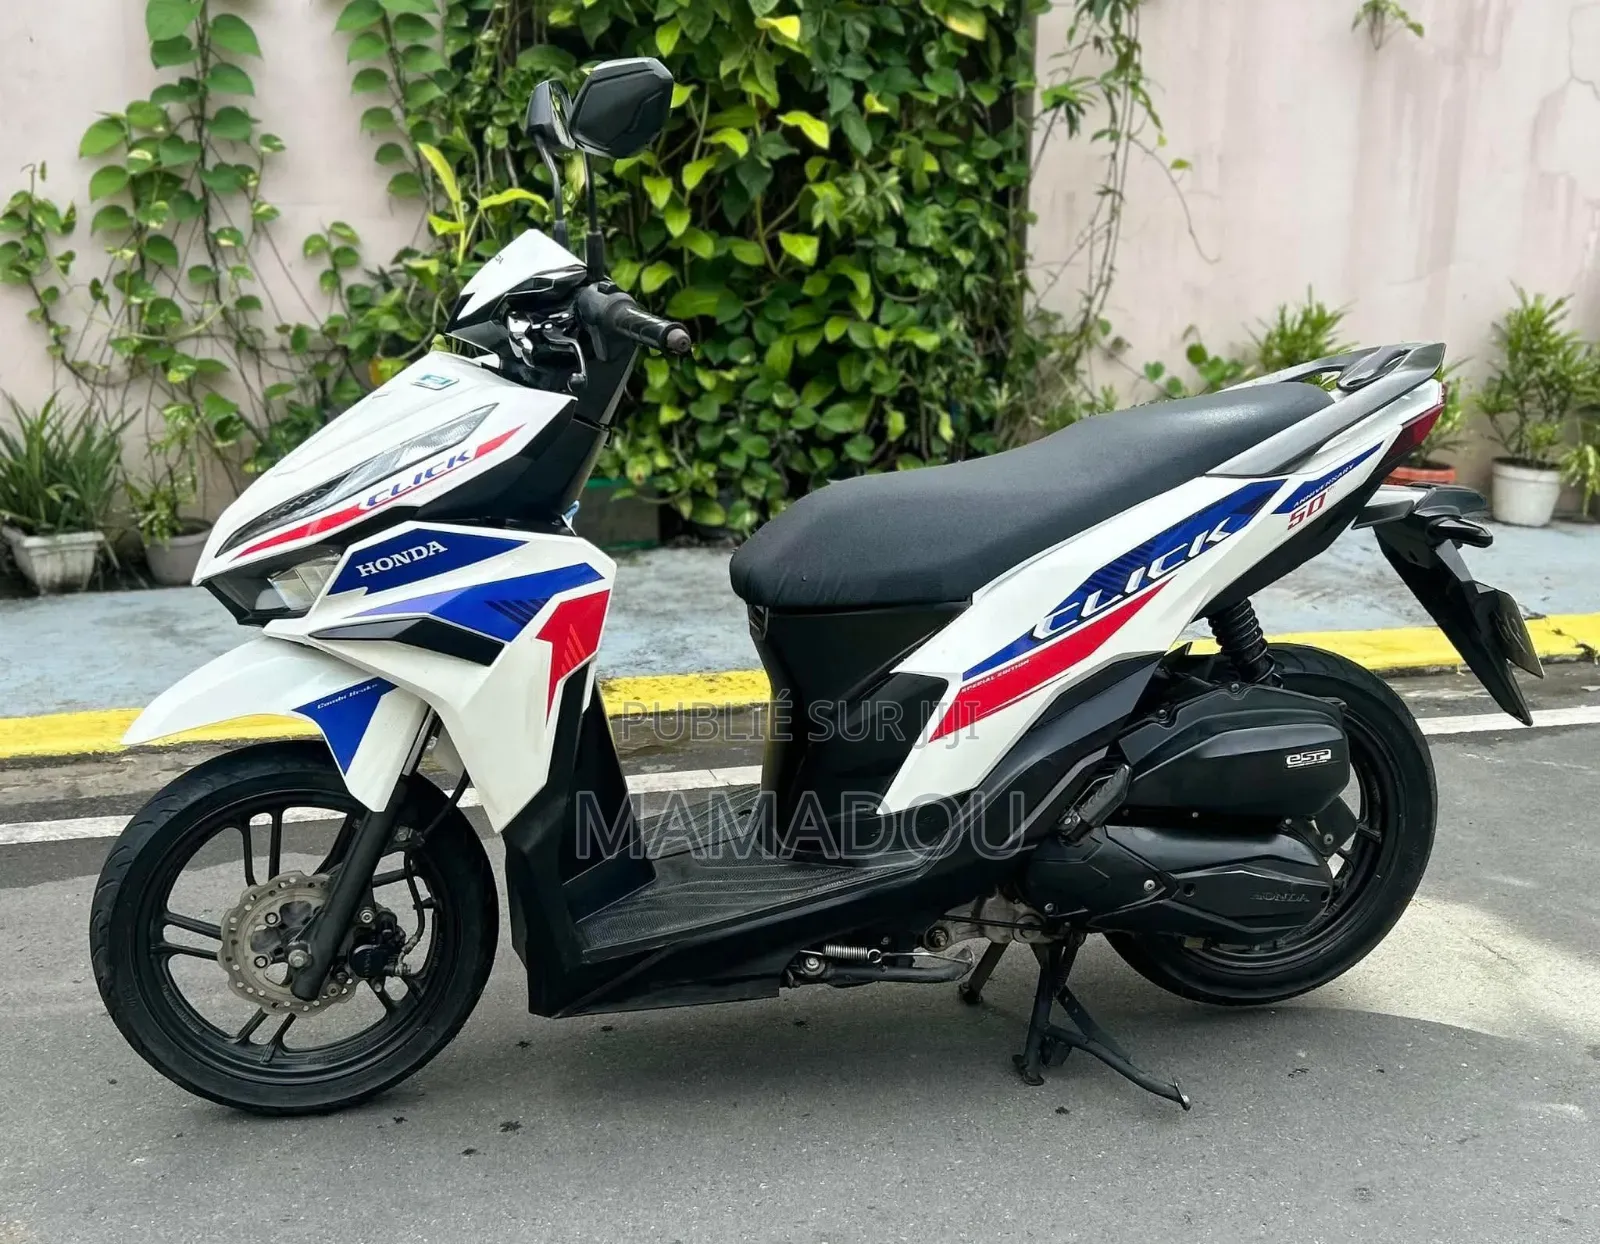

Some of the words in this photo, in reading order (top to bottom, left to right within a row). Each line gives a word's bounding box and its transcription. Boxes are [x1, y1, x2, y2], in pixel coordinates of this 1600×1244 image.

[367, 450, 470, 506] CLICK
[1293, 463, 1354, 508] ANNIVERSARY
[356, 541, 448, 577] HONDA
[1032, 517, 1231, 640] CLICK
